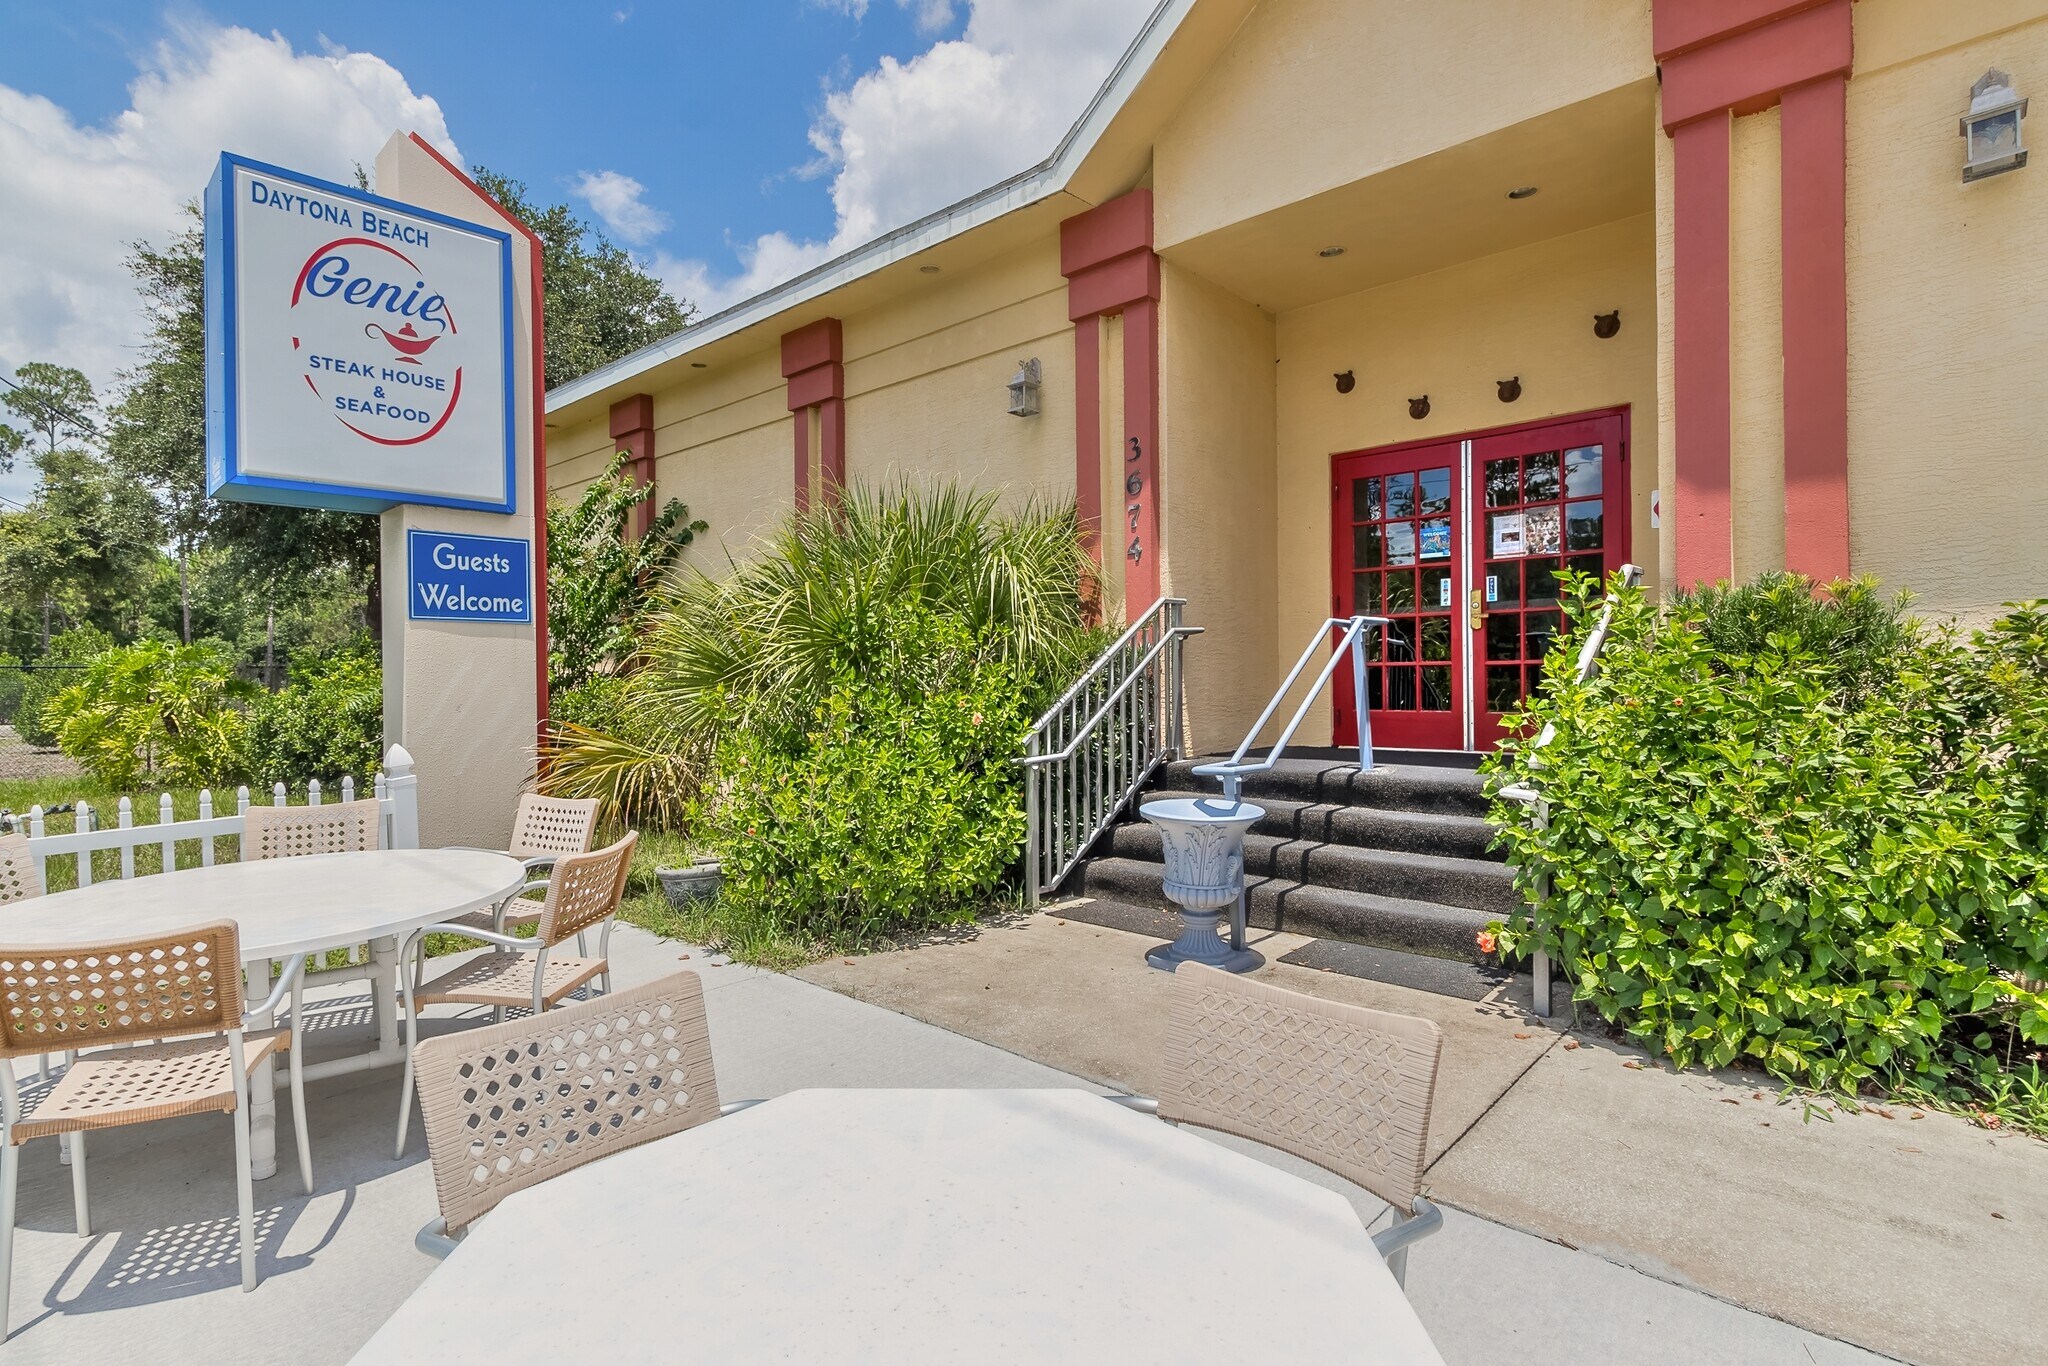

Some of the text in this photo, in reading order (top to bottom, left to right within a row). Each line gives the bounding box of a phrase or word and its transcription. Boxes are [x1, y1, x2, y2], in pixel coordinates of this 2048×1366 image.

[251, 181, 429, 248] DAYTONA BEACH
[306, 256, 446, 333] Genie
[309, 355, 446, 391] STEAK HOUSE
[373, 385, 386, 399] &
[335, 396, 431, 424] SEAFOOD
[1126, 436, 1143, 564] 3674
[432, 542, 510, 574] Guests
[417, 582, 523, 613] Welcome
